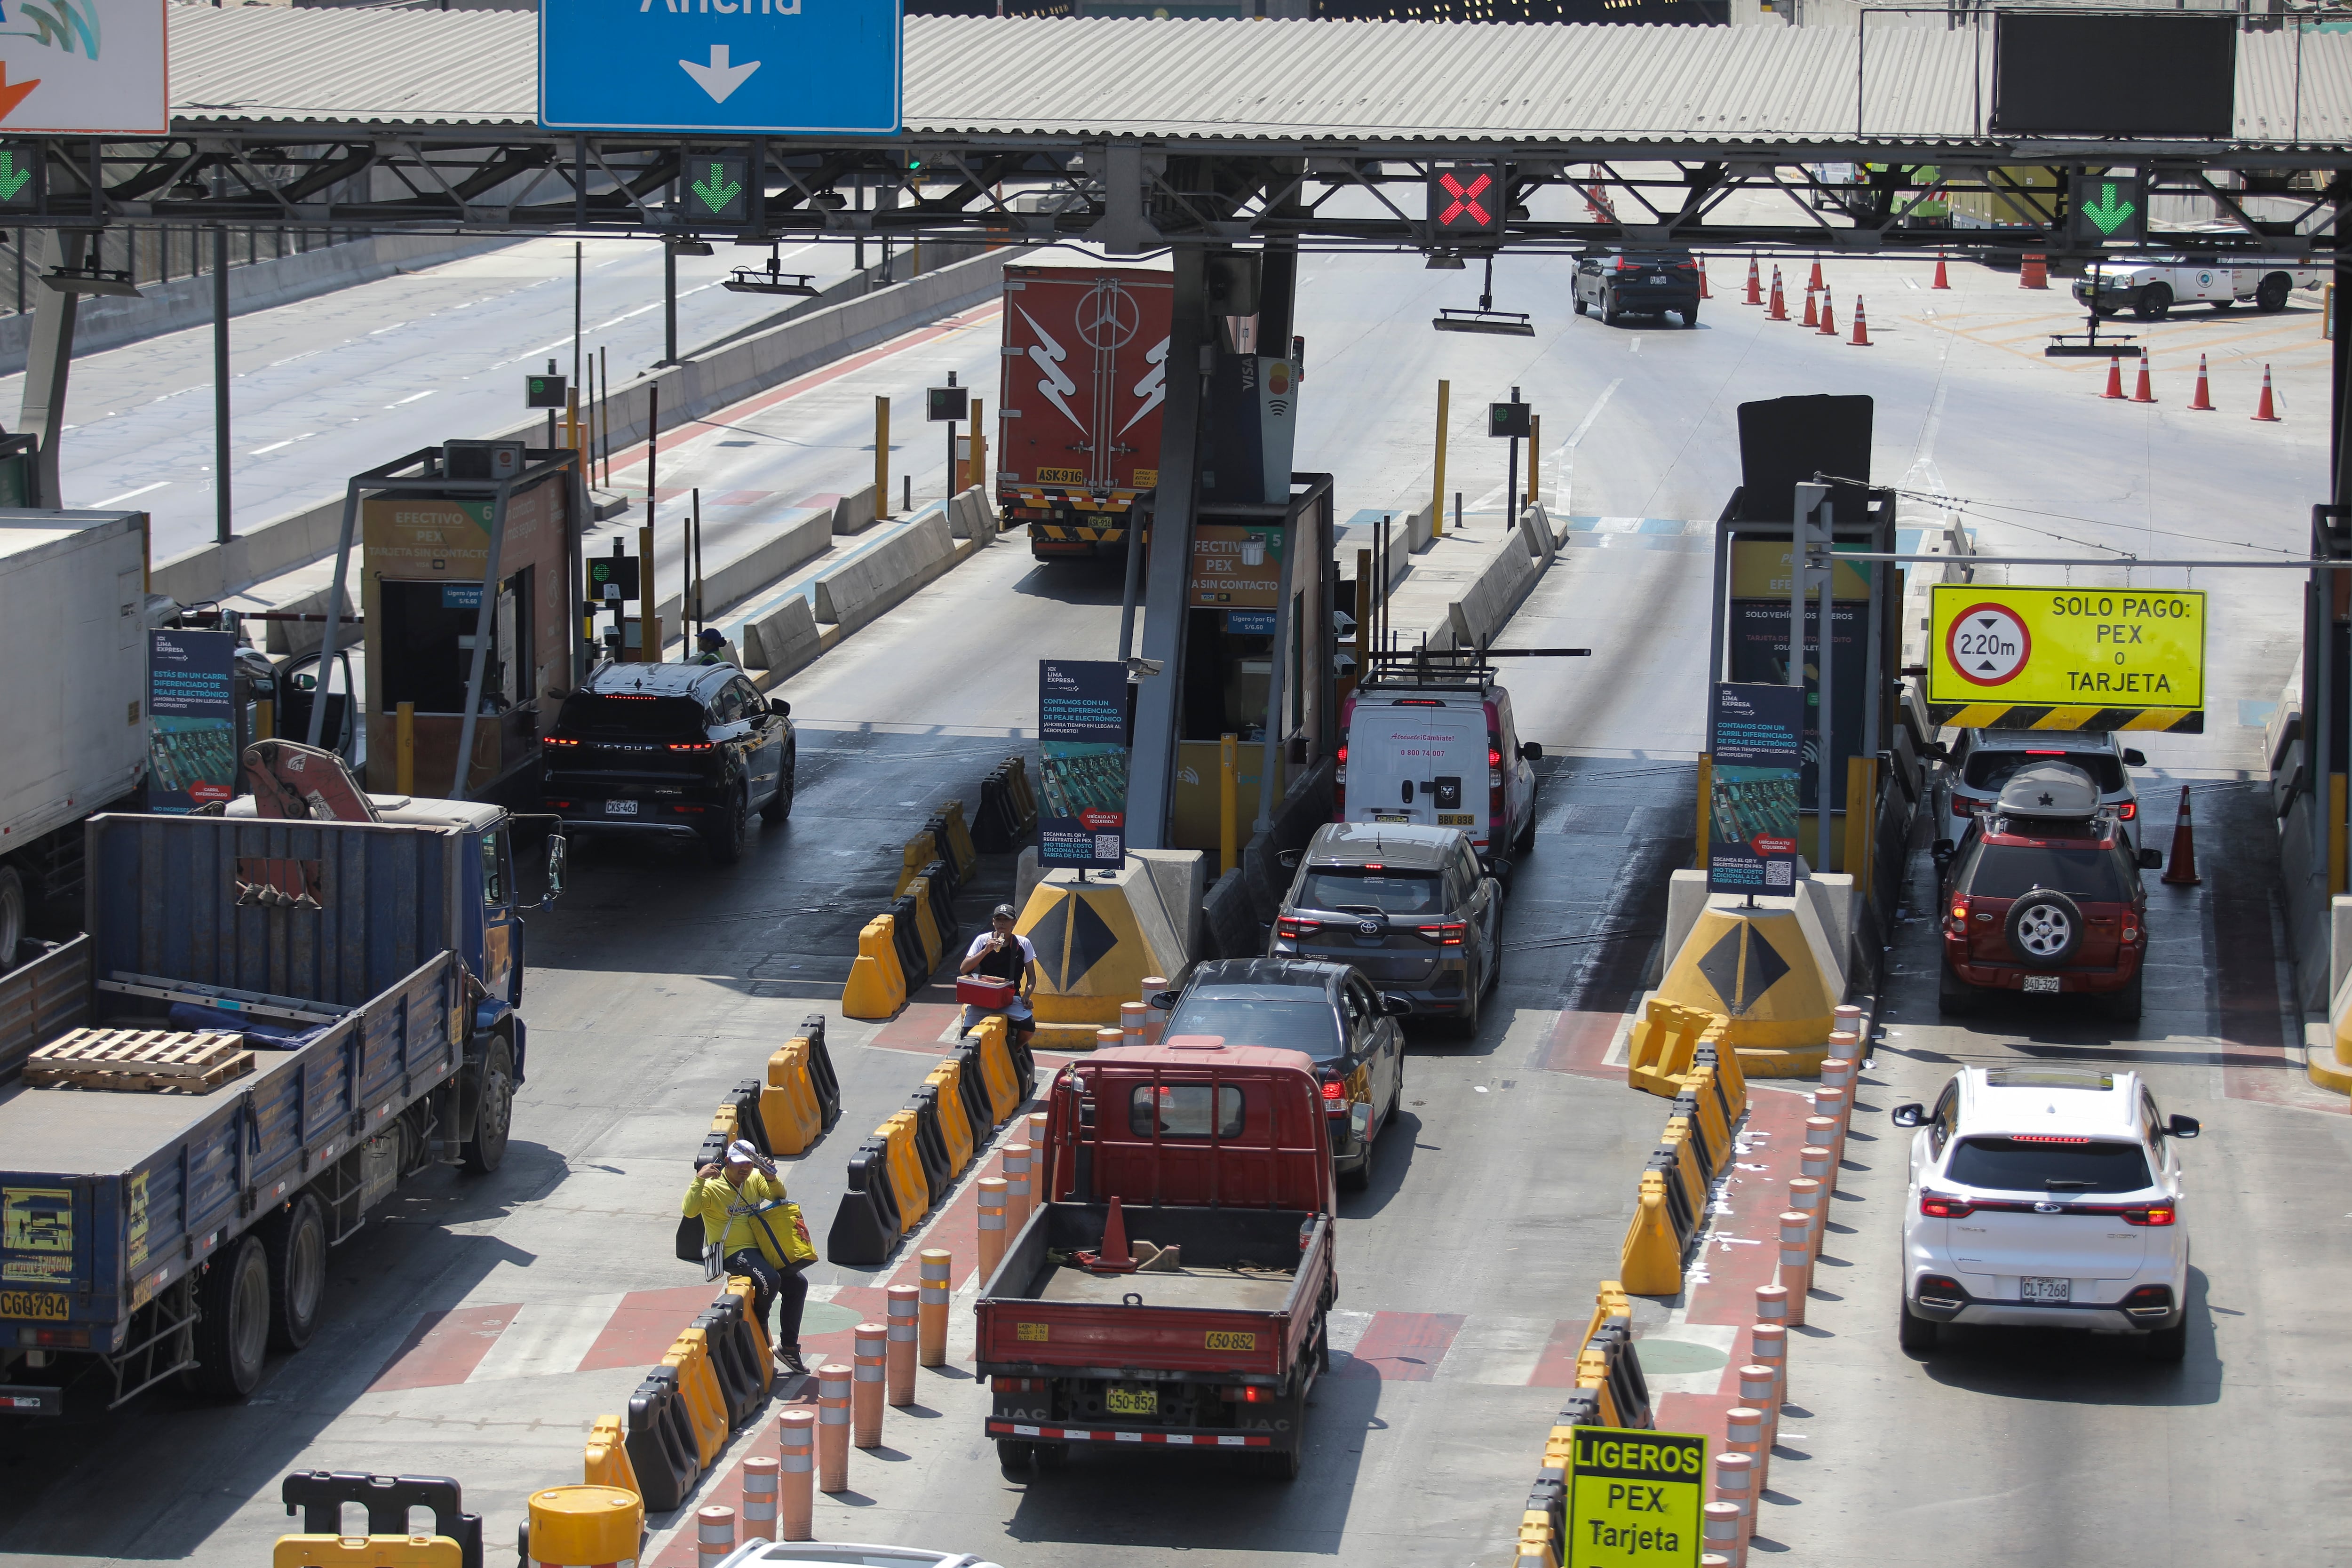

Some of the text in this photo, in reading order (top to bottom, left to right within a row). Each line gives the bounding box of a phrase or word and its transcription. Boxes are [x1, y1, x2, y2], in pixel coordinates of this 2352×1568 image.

[1242, 358, 1253, 391] VISA
[396, 512, 463, 525] EFECTIVO
[483, 506, 493, 520] 6
[417, 531, 444, 542] PEX
[1273, 534, 1281, 547] 5
[368, 547, 413, 557] TARJETA
[414, 548, 430, 557] SIN
[1206, 560, 1232, 571] PEX
[1200, 580, 1217, 589] SIN
[1220, 581, 1278, 590] CONTACTO
[2052, 597, 2191, 618] SOLO PAGO:
[2097, 625, 2142, 644] PEX
[1961, 634, 2015, 656] 2.20m
[2067, 672, 2170, 692] TARJETA
[178, 689, 229, 698] ELECTRÓNICO
[607, 803, 636, 812] CKS-461
[2024, 1283, 2066, 1297] CLT-268
[1108, 1394, 1154, 1410] C50-852
[998, 1408, 1047, 1420] JAC
[1575, 1440, 1700, 1474] LIGEROS
[1608, 1483, 1664, 1513] PEX
[1588, 1519, 1678, 1555] Tarjeta
